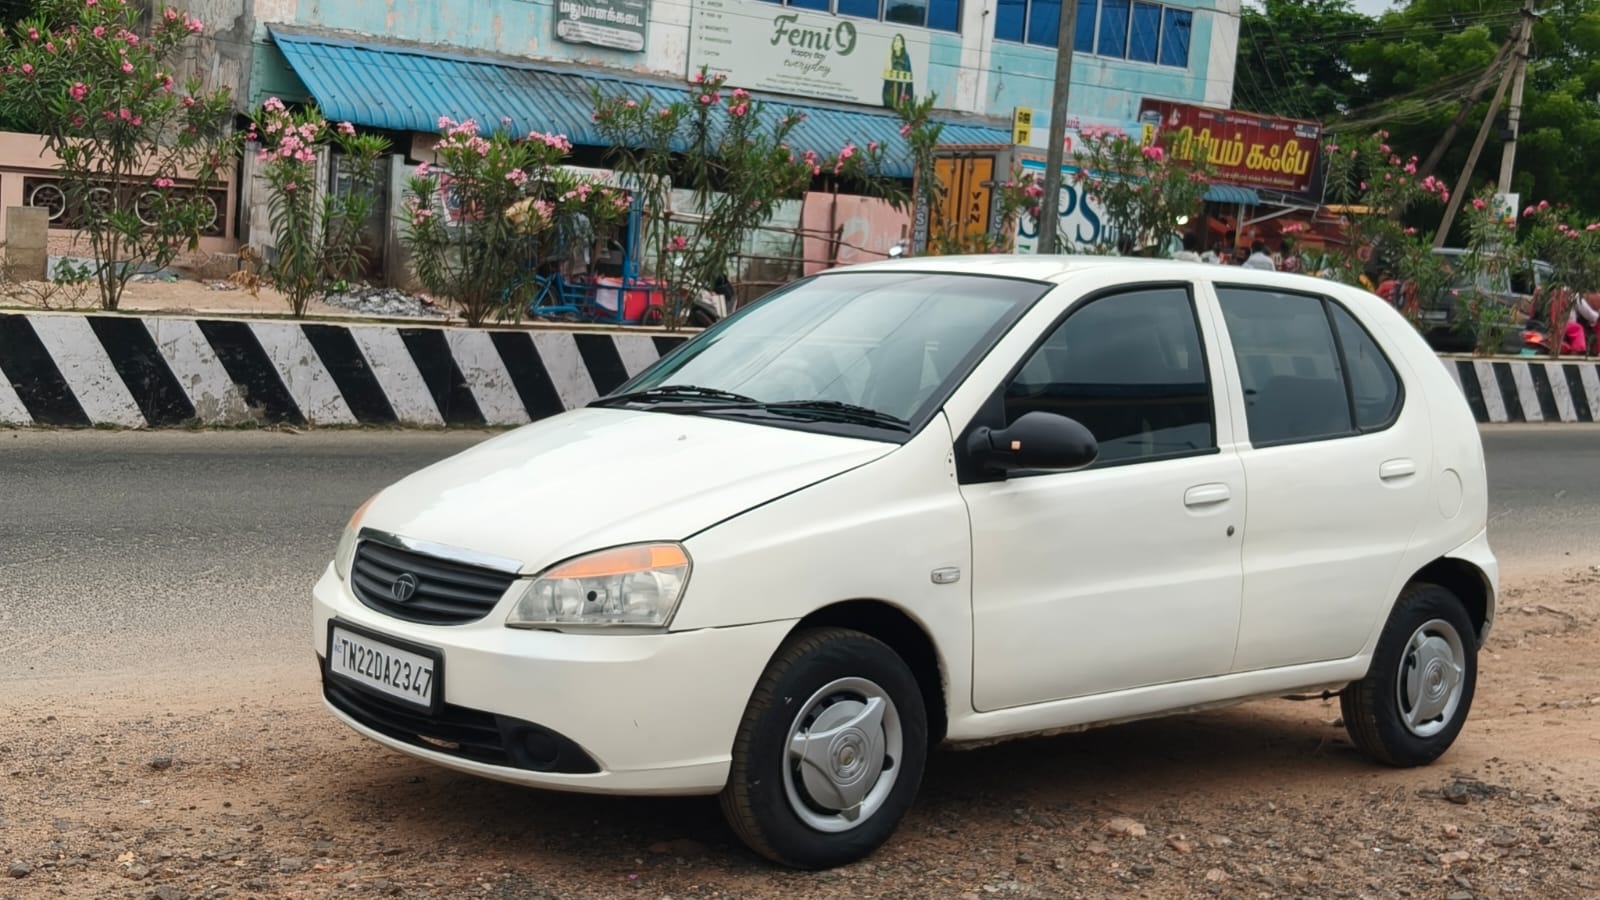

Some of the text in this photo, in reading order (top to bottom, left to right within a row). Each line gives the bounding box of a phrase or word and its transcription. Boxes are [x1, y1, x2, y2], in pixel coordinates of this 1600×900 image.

[1246, 139, 1309, 175] கஃபே
[970, 191, 982, 224] VAN
[342, 639, 432, 697] TN22DA2347
